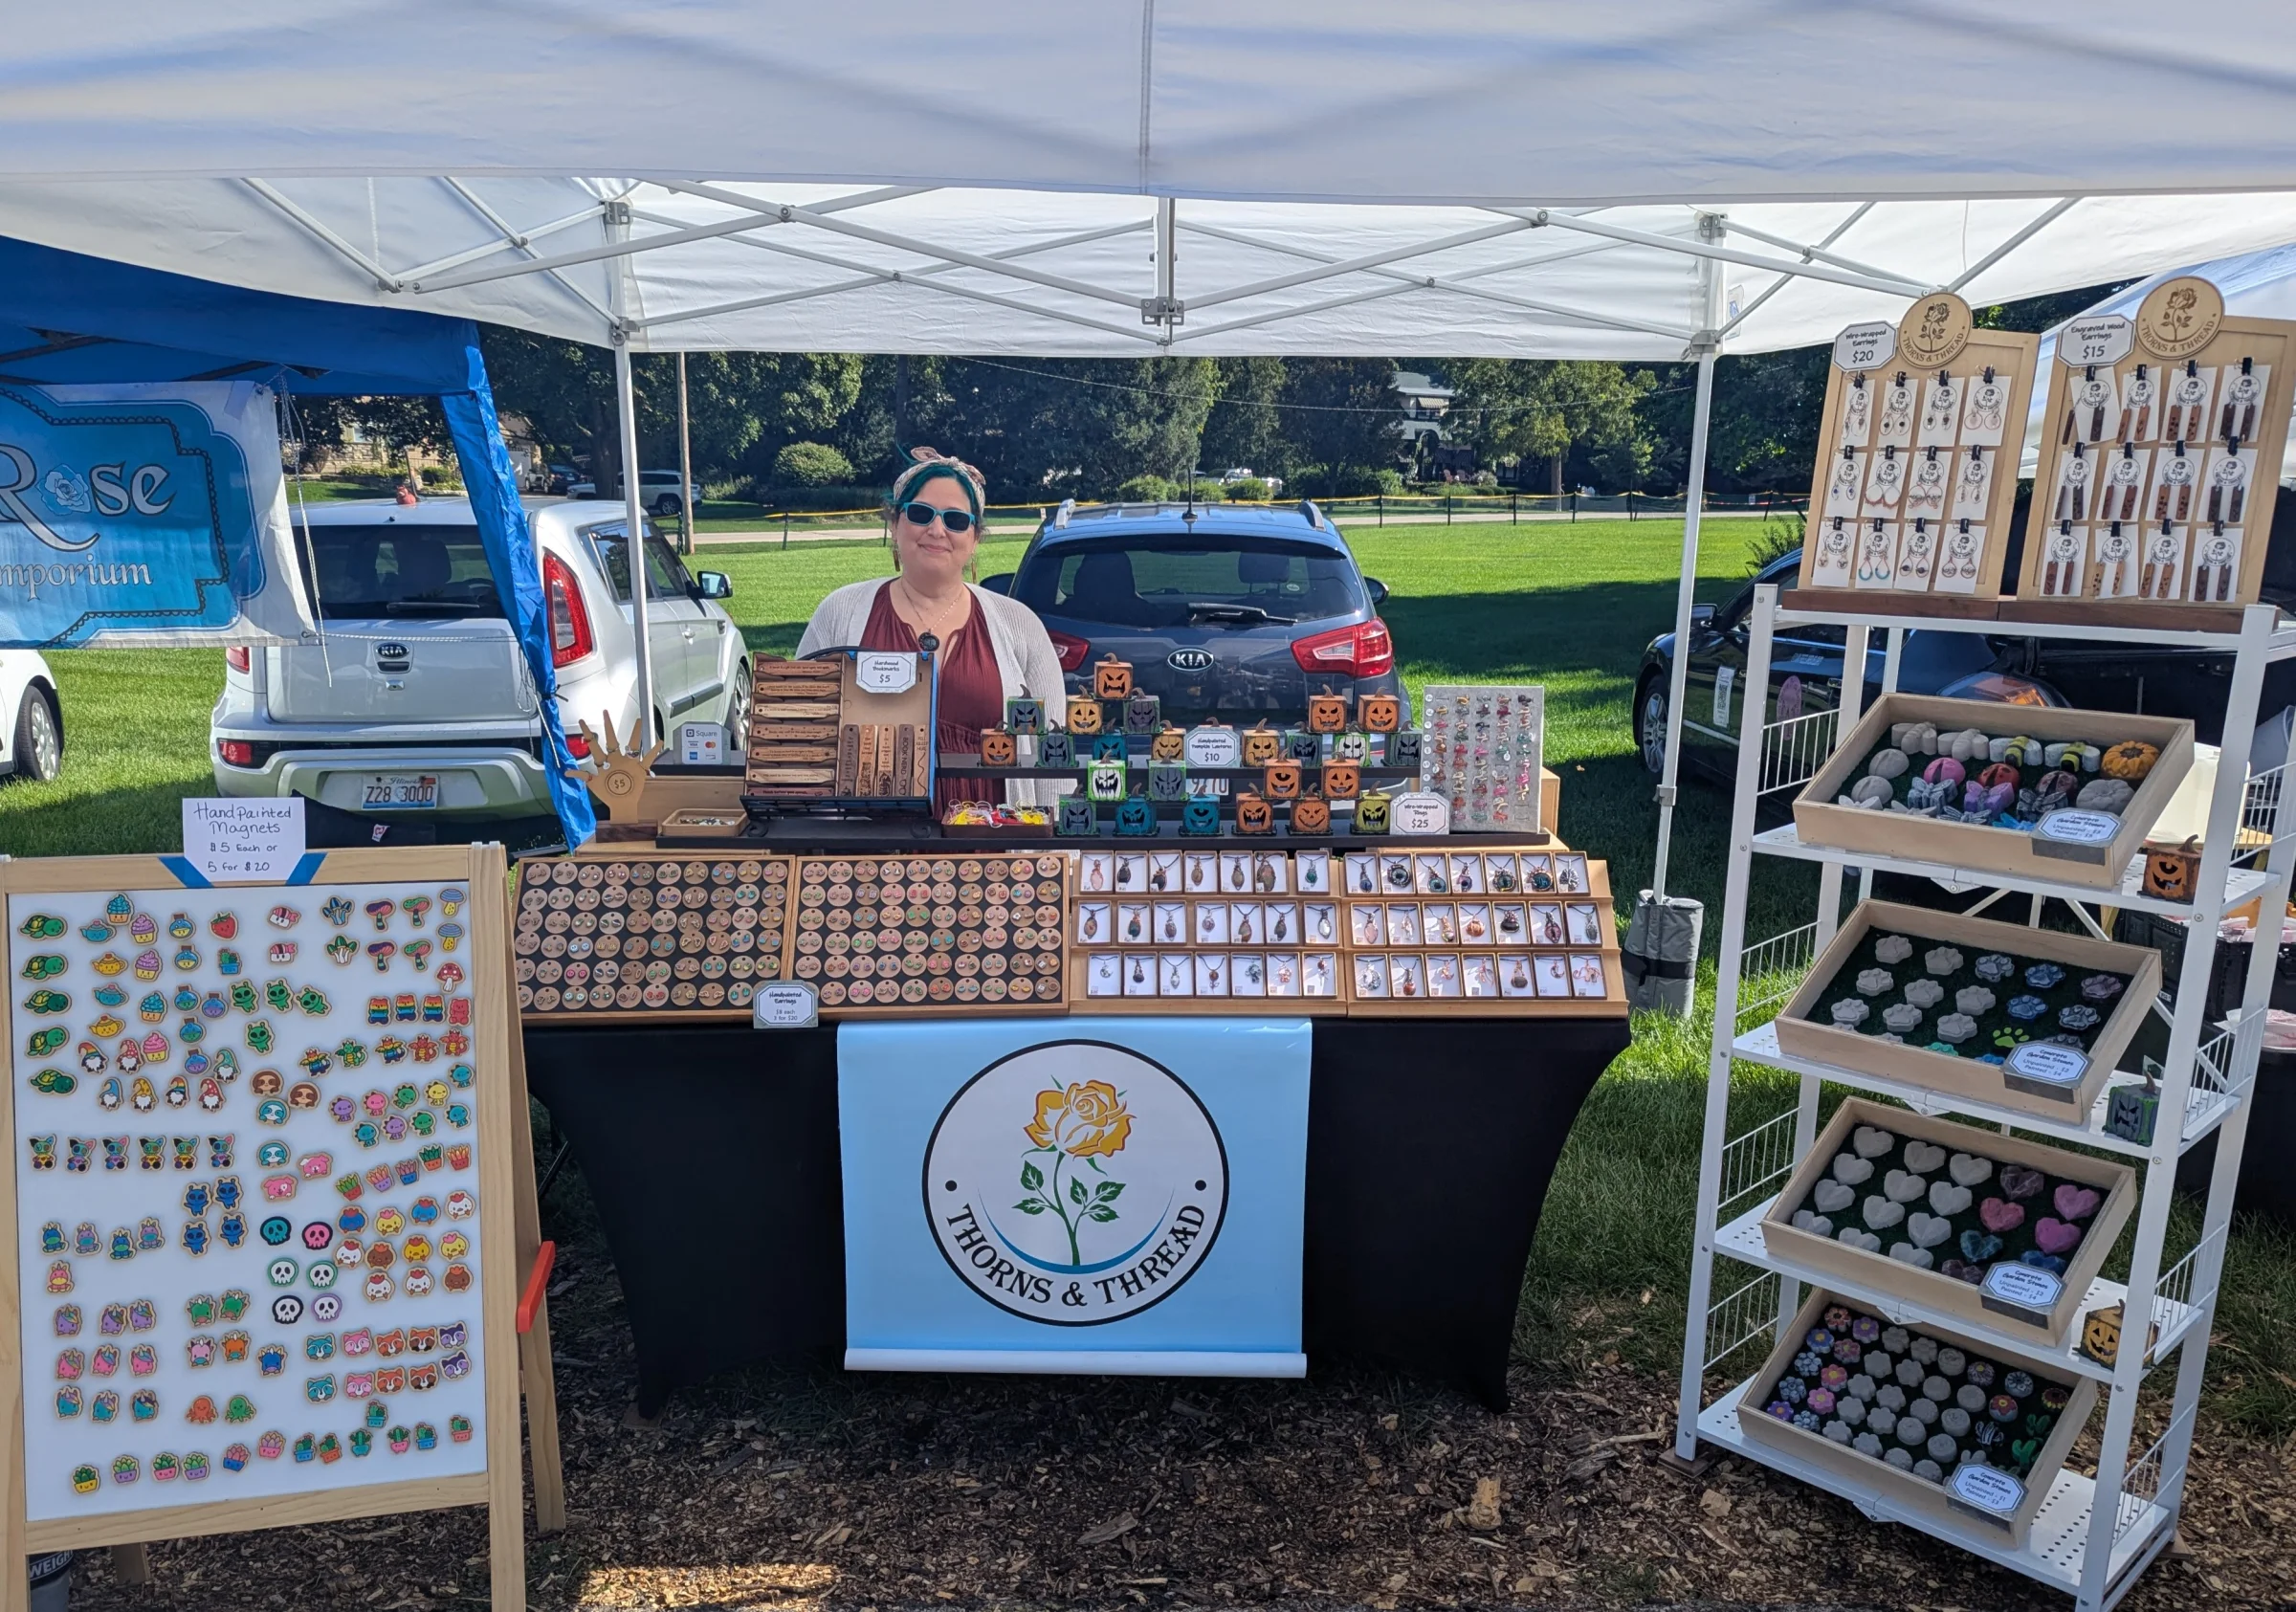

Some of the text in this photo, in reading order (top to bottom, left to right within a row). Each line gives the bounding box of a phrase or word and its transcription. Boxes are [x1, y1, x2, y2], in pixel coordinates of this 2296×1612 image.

[2142, 325, 2168, 352] THORNS
[2180, 320, 2215, 351] THREAD
[1903, 337, 1925, 362] THORNS
[1934, 333, 1964, 361] THREAD
[2083, 345, 2105, 360] $15
[1852, 350, 1874, 364] $20
[382, 646, 403, 655] KIA
[1176, 653, 1206, 666] KIA
[879, 674, 891, 683] $5
[1204, 752, 1220, 762] $10
[614, 779, 626, 788] $5
[365, 785, 433, 803] Z28 3000
[210, 820, 280, 839] Magnets
[1412, 819, 1428, 828] $25
[208, 861, 217, 872] 5
[2023, 1059, 2055, 1070] Unpainted
[946, 1203, 1205, 1306] THORNS & THREAD
[2002, 1272, 2025, 1283] Garden
[2015, 1270, 2042, 1281] Concrete
[1999, 1280, 2030, 1292] Unpainted
[2000, 1286, 2022, 1296] Painted
[1968, 1473, 1990, 1486] Garden
[1980, 1472, 2005, 1486] Concrete
[1965, 1481, 1994, 1496] Unpainted
[1965, 1488, 1986, 1499] Painted
